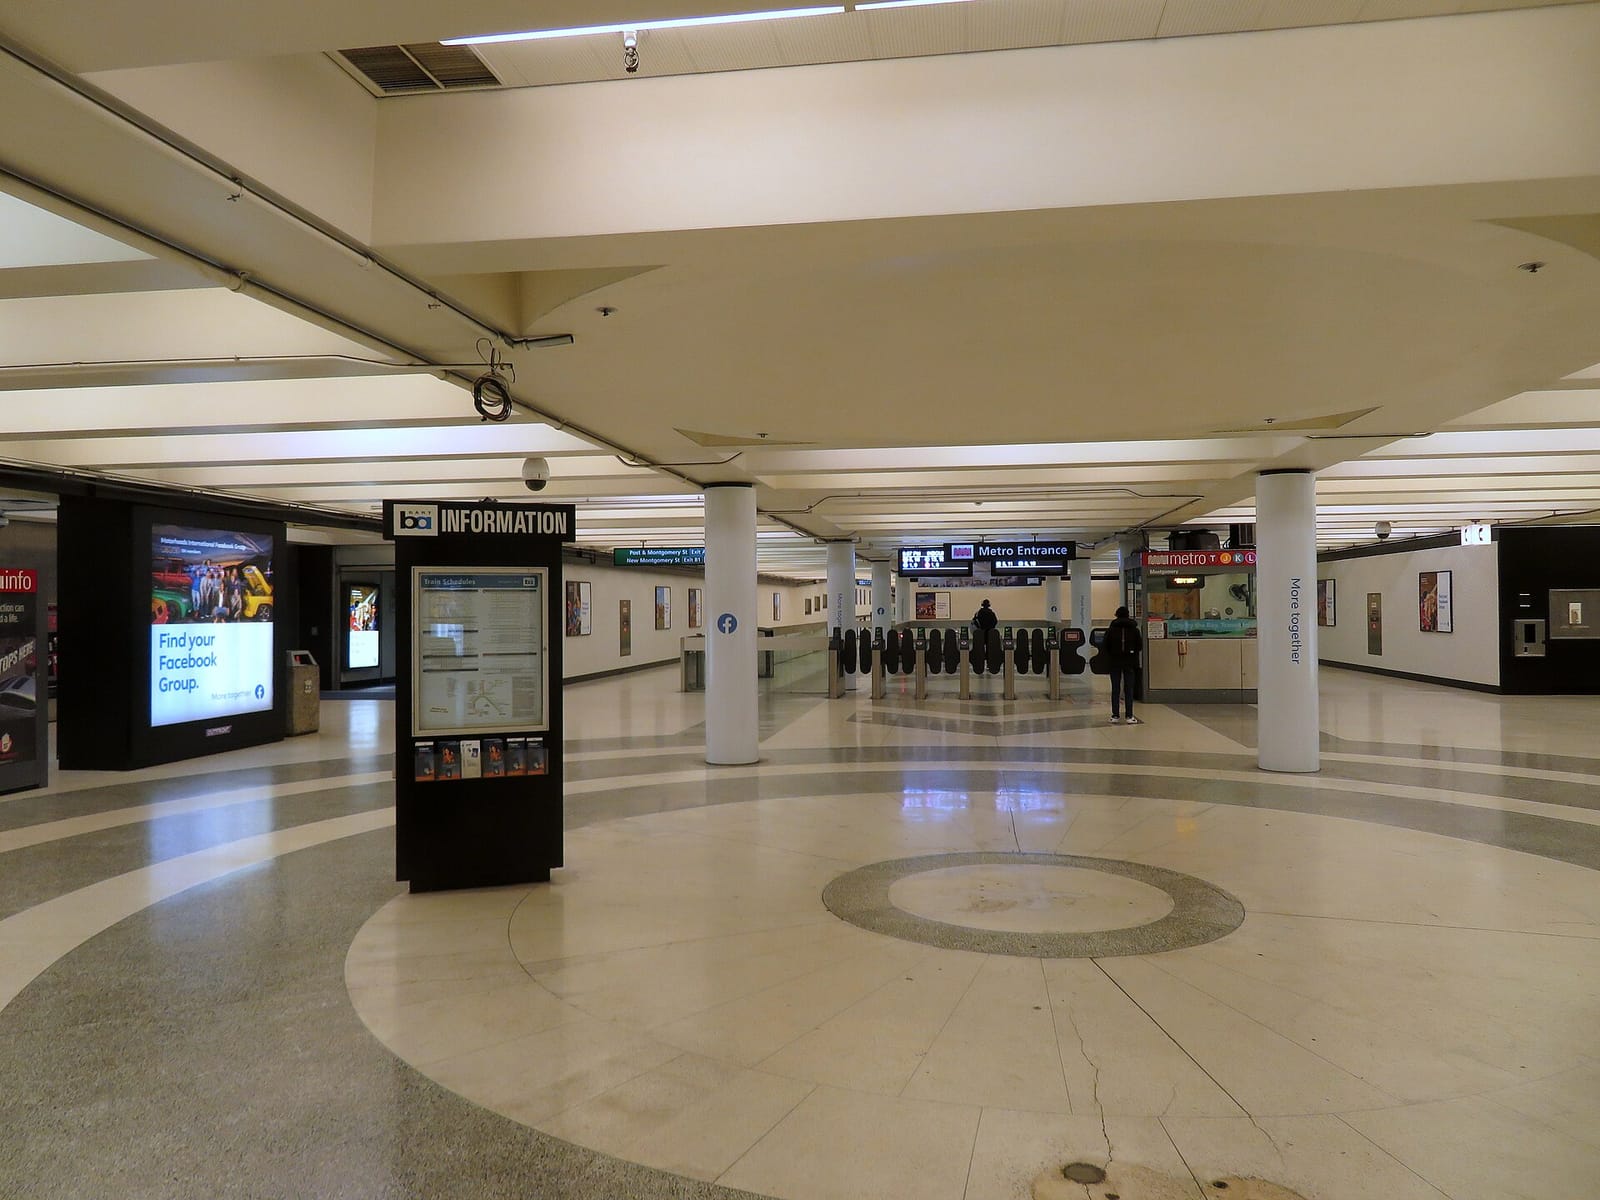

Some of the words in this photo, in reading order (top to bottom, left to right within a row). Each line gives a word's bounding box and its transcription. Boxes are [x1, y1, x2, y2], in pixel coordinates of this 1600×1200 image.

[441, 509, 567, 534] INFORMATION
[979, 546, 1014, 556] Metro
[1017, 545, 1068, 555] Entrance
[1170, 553, 1206, 565] metro
[1209, 554, 1216, 562] T
[442, 578, 476, 586] Schedules
[1291, 578, 1301, 609] More
[159, 632, 187, 648] Find
[188, 635, 216, 651] your
[1288, 612, 1303, 664] together
[159, 651, 217, 671] Facebook
[158, 676, 199, 694] Group.
